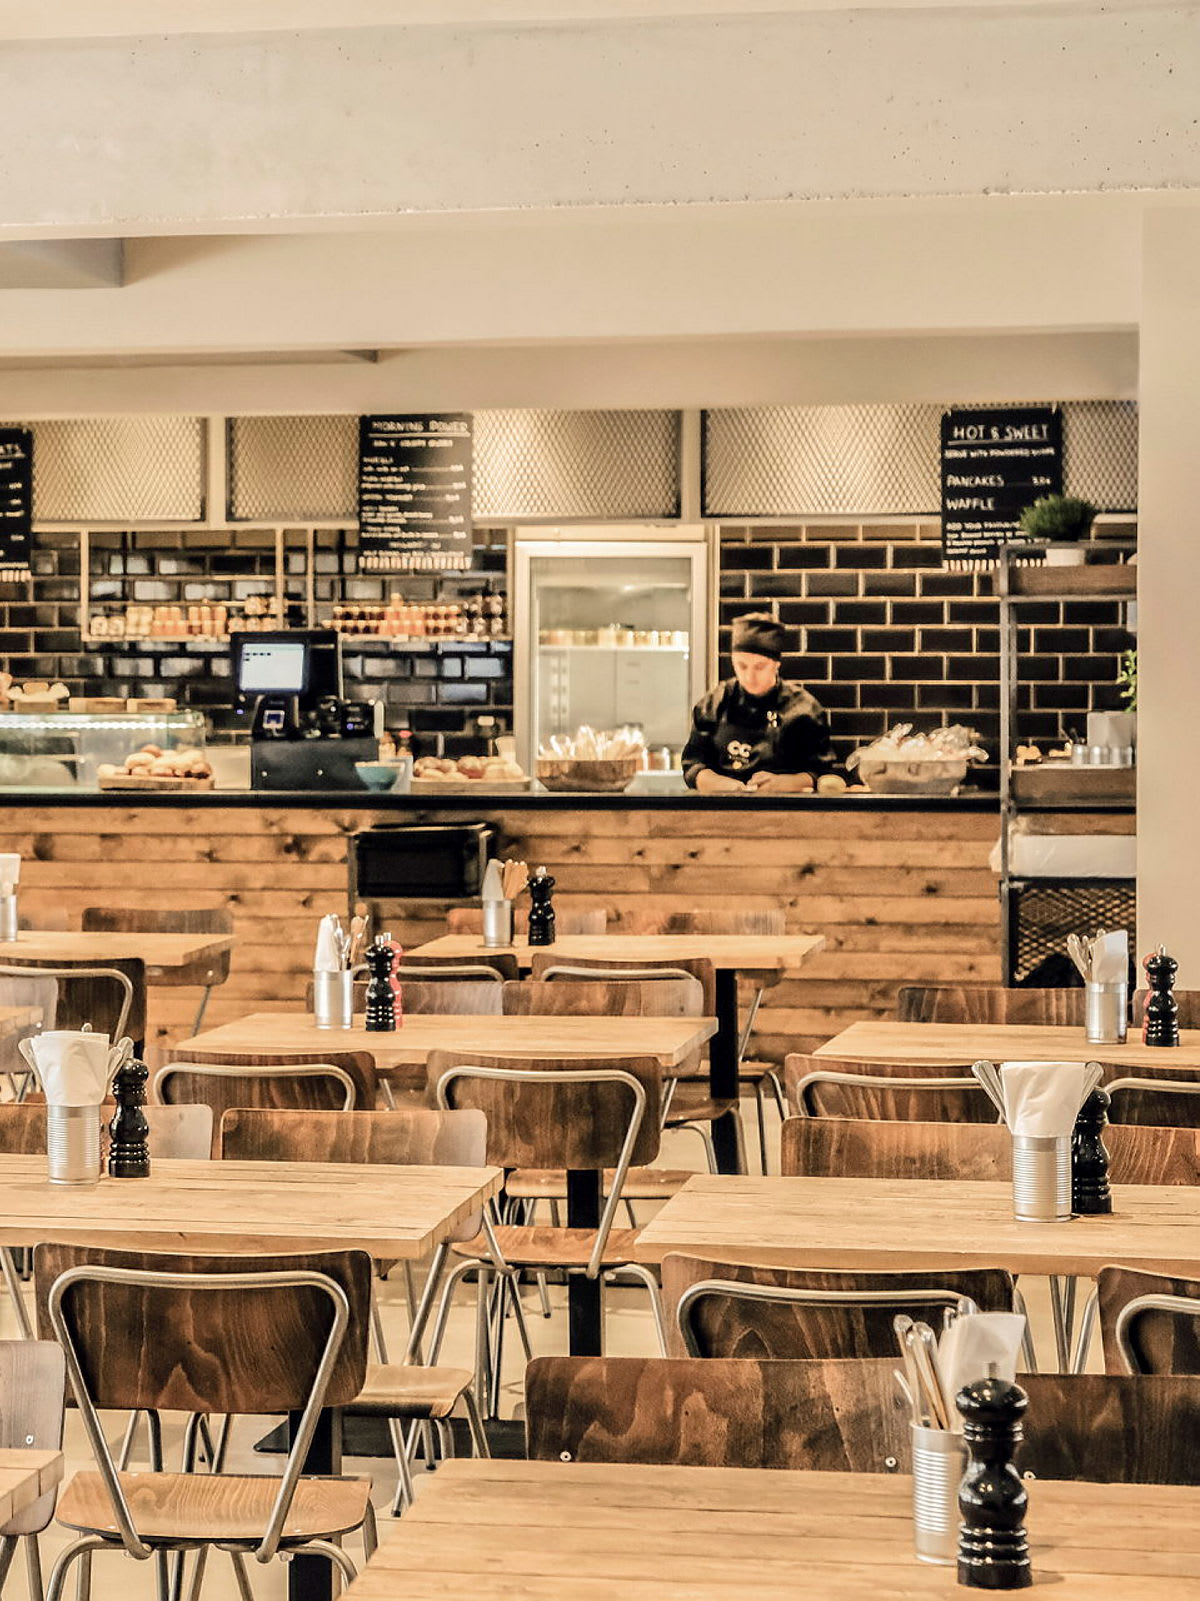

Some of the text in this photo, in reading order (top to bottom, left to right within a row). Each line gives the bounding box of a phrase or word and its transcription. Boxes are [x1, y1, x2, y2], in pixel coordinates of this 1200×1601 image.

[953, 424, 1048, 441] HOT & SWEET
[946, 475, 1004, 487] PANCAKES
[946, 498, 994, 511] WAFFLE
